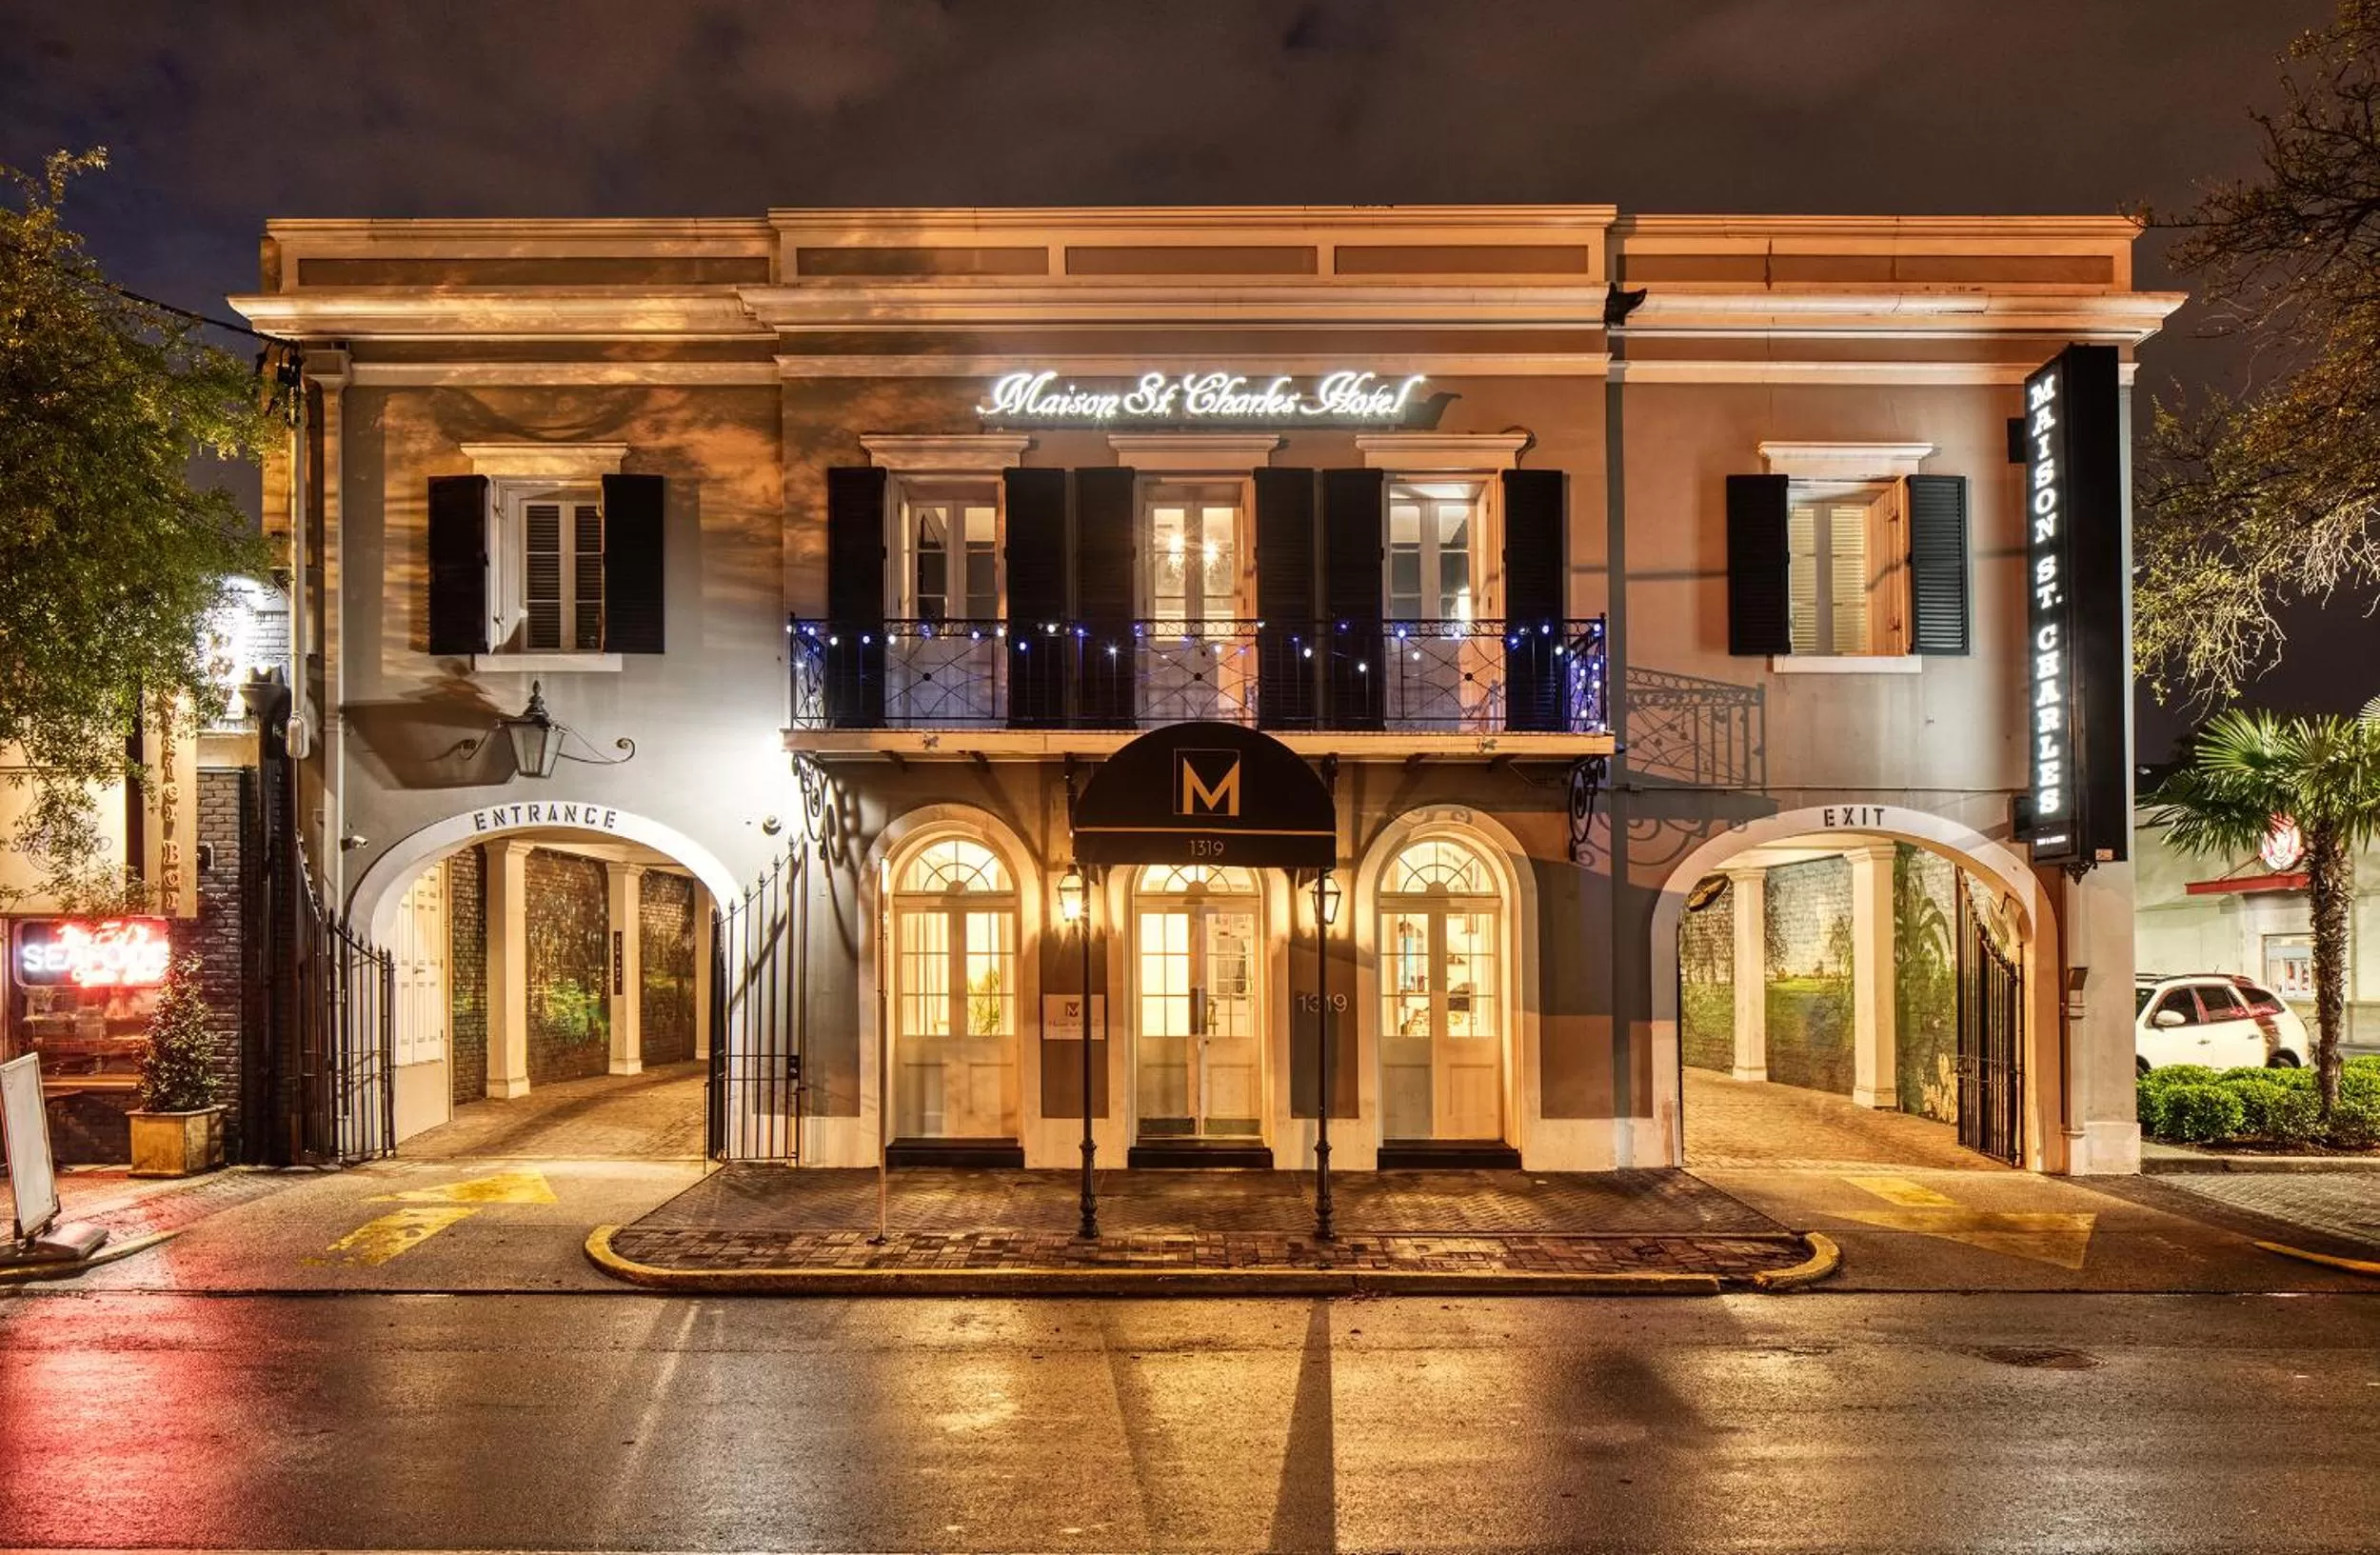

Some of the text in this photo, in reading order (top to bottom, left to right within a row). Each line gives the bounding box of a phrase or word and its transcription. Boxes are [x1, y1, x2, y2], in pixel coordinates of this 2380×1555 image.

[976, 370, 1121, 416] Maison
[1183, 372, 1300, 415] Charles
[1299, 371, 1426, 414] Hotel
[2030, 373, 2057, 544] MAISON
[2035, 554, 2062, 609] ST.
[2034, 623, 2062, 816] CHARLES
[1182, 757, 1240, 816] M
[474, 805, 617, 831] ENTRANCE
[1824, 807, 1885, 827] EXIT
[1190, 839, 1225, 856] 1319
[1298, 992, 1349, 1013] 1319
